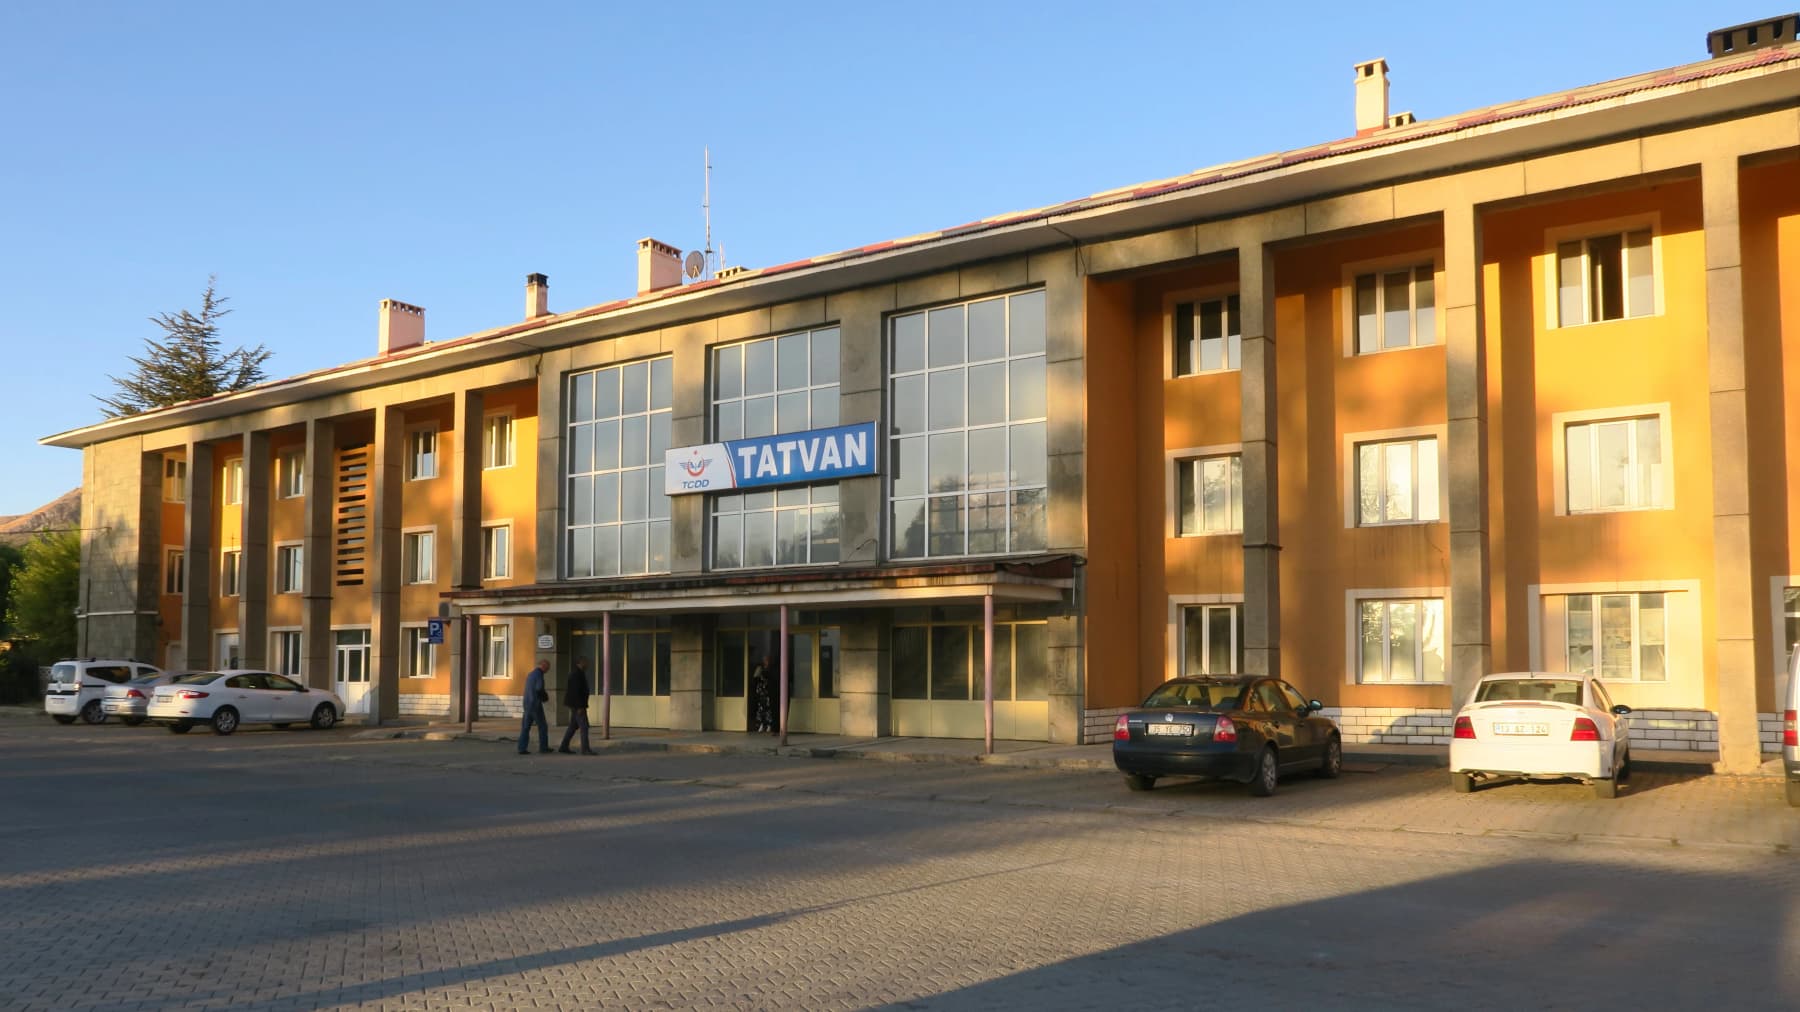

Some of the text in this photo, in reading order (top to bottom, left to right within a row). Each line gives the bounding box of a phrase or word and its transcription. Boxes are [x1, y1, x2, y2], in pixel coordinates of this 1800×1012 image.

[738, 431, 867, 479] TATVAN
[682, 479, 710, 489] TCDD
[429, 622, 440, 636] P
